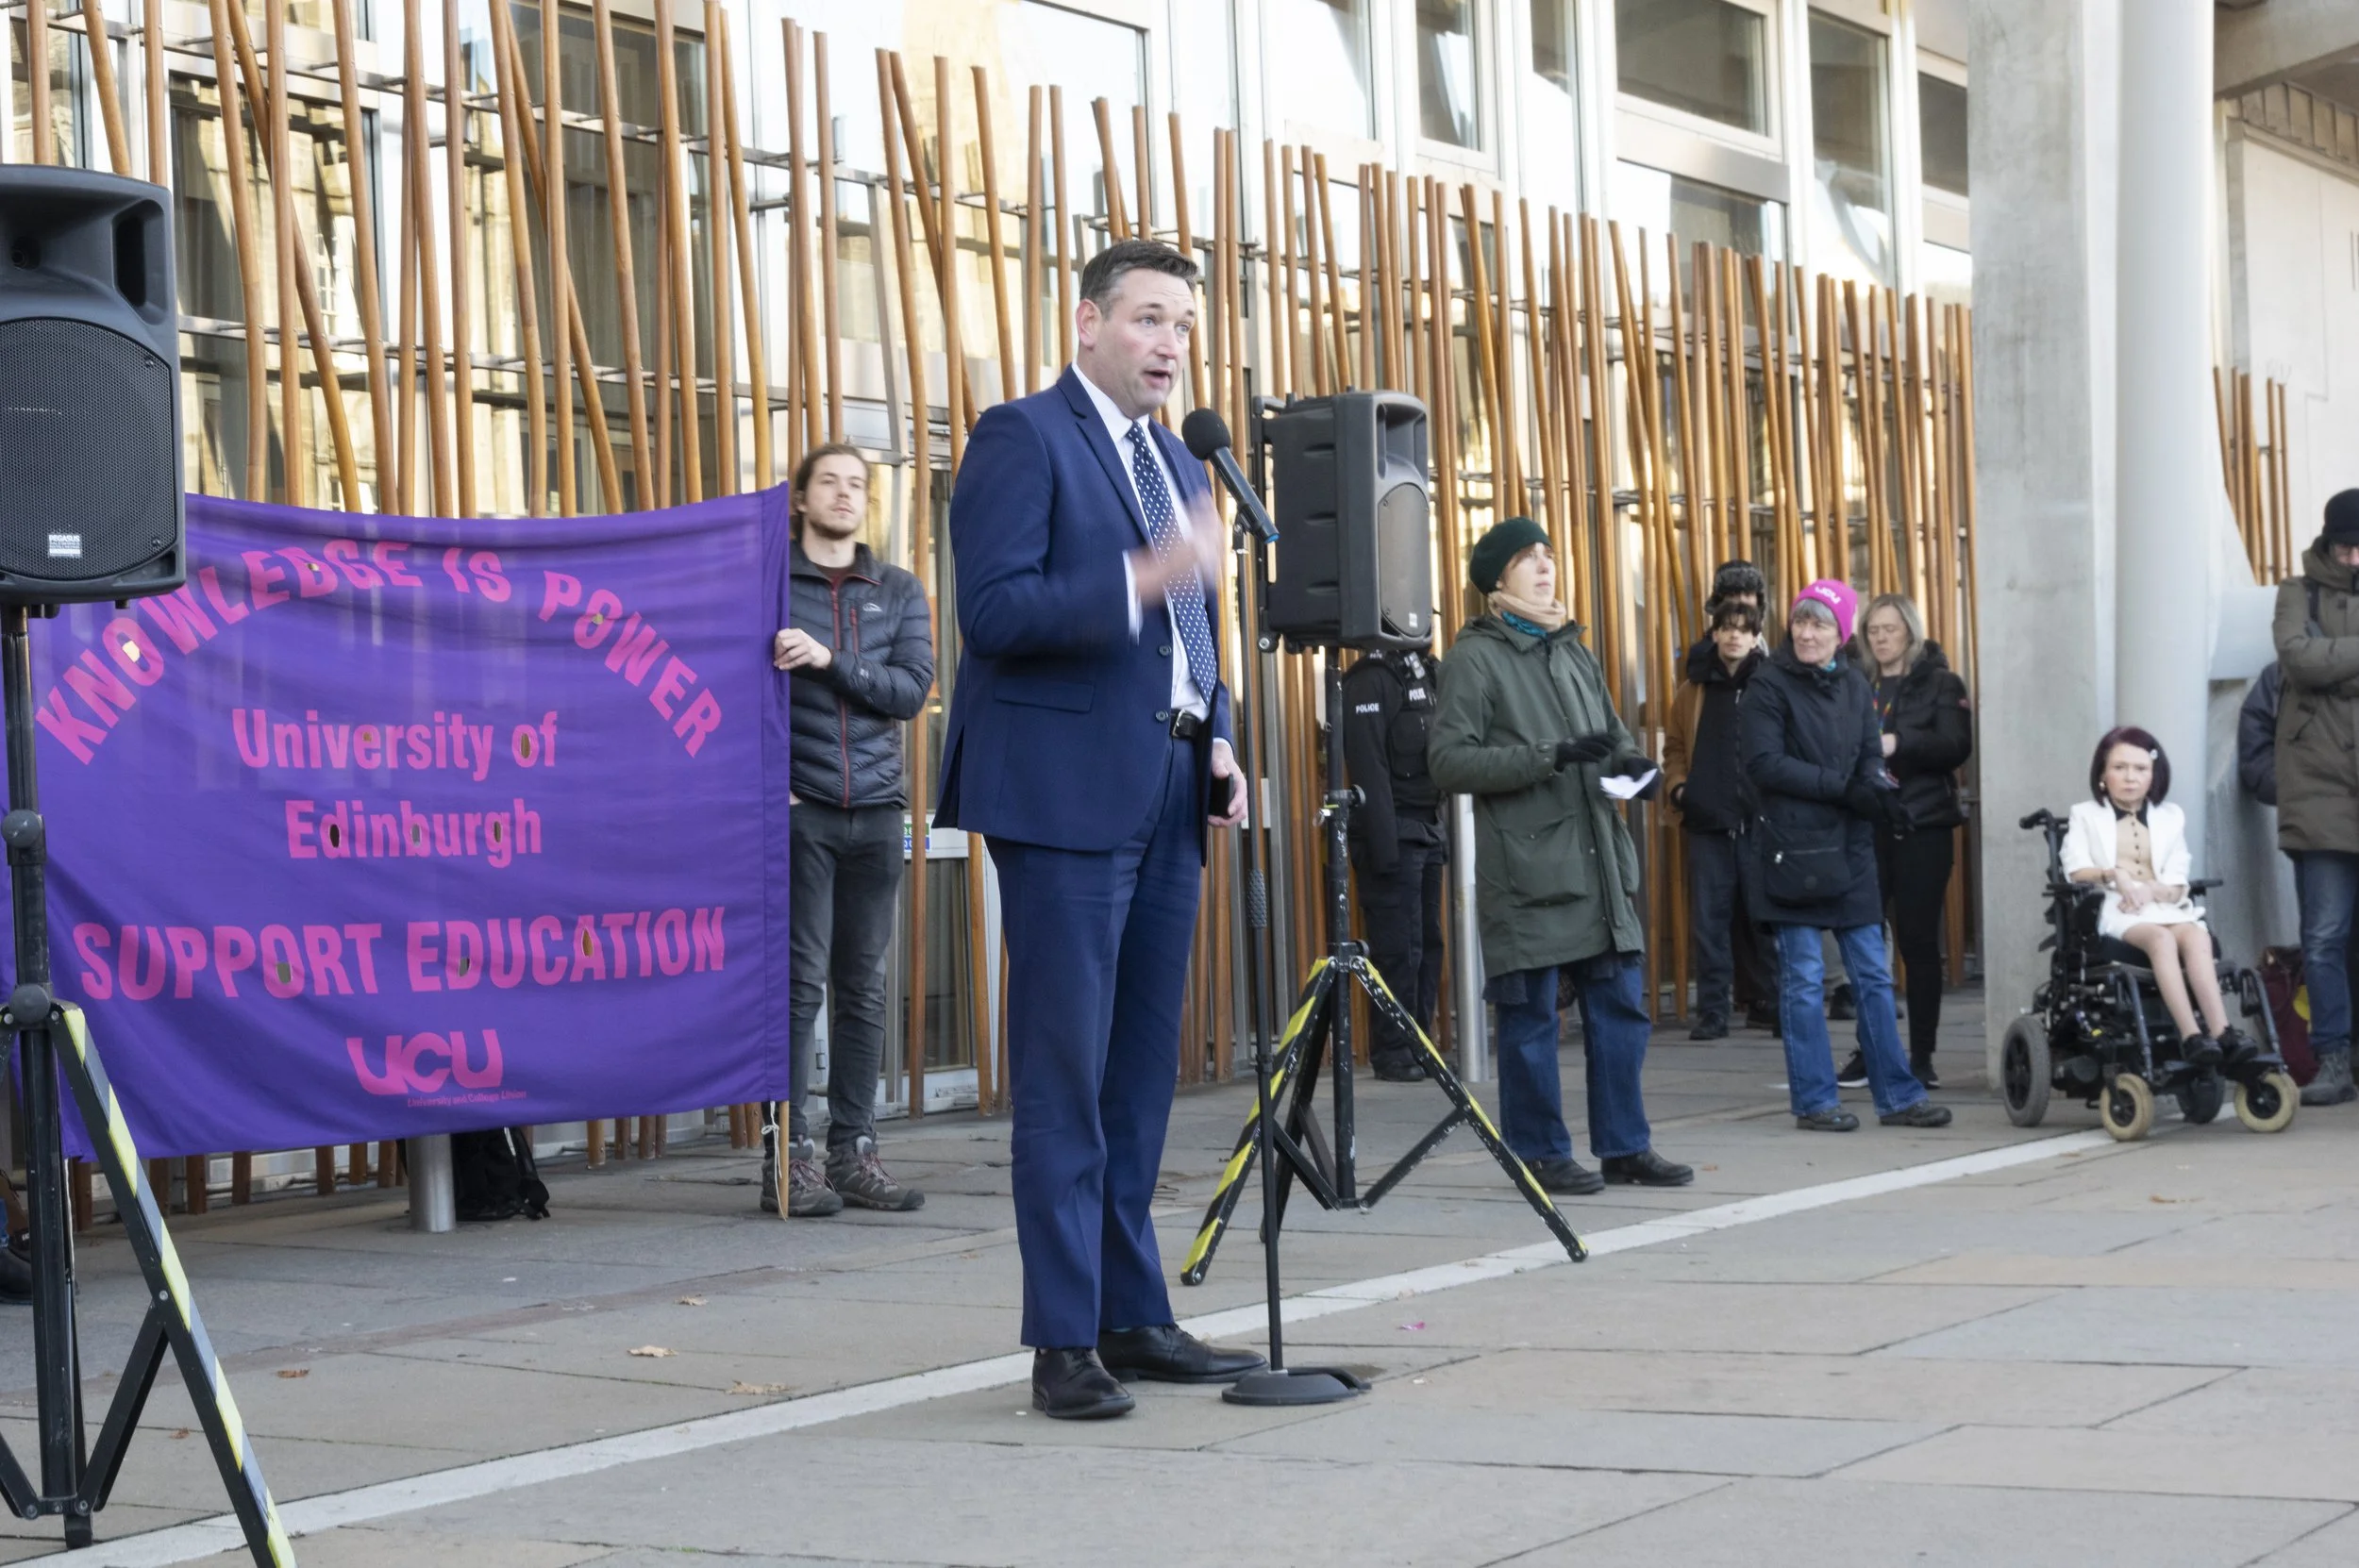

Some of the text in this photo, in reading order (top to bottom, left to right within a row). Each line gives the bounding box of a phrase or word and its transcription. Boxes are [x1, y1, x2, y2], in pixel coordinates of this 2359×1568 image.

[35, 539, 723, 765] KNOWLEDGE IS POWER
[1356, 703, 1380, 714] POLICE
[232, 709, 558, 781] University of
[286, 798, 542, 868] Edinburgh
[73, 907, 726, 1000] SUPPORT EDUCATION
[346, 1029, 504, 1095] UCU
[407, 1096, 451, 1108] University
[467, 1093, 500, 1103] College
